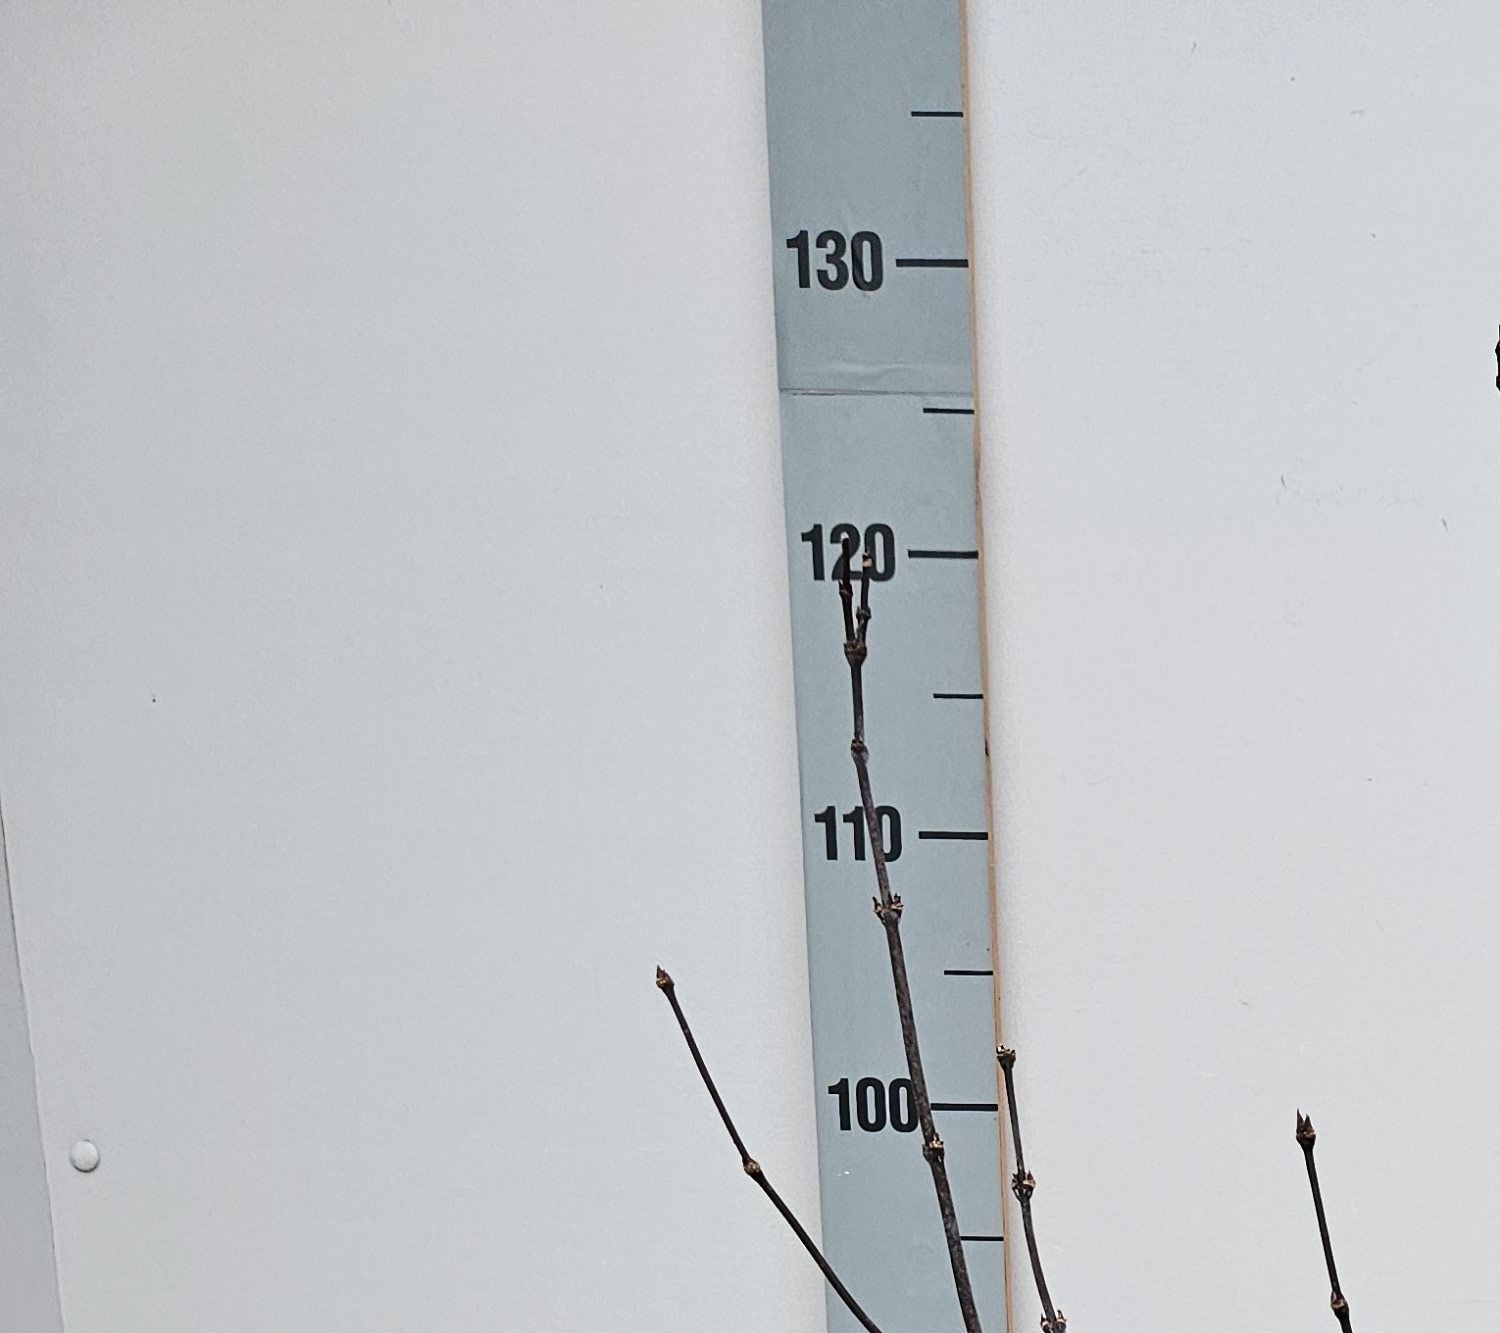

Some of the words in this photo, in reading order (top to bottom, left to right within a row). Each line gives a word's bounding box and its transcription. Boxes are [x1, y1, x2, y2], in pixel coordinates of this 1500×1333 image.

[787, 231, 883, 292] 130
[801, 523, 895, 581] 120
[815, 805, 903, 863] 110
[828, 1077, 920, 1133] 100
